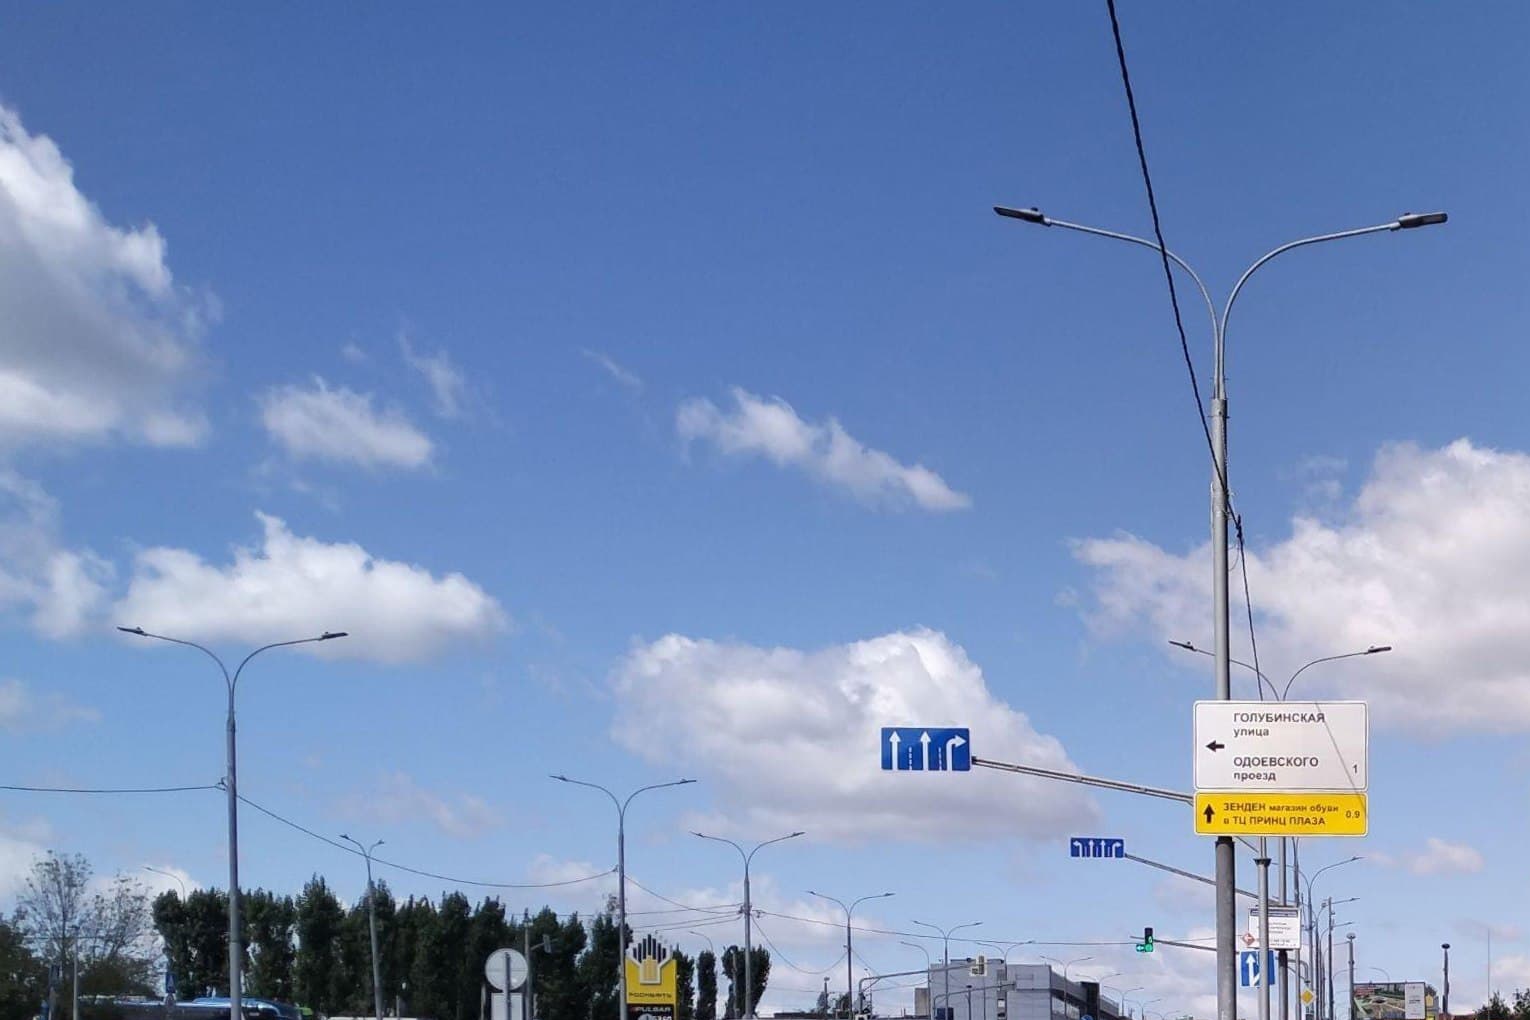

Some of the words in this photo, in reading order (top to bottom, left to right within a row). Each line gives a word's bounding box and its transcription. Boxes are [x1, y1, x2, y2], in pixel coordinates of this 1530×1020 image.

[1233, 712, 1326, 723] ГОЛУБИНСКАЯ
[1233, 727, 1270, 738] улица
[1233, 756, 1319, 769] ОДОЕВСКОГО
[1352, 764, 1359, 775] 1
[1233, 772, 1276, 782] проезд
[1223, 802, 1266, 812] ЗЕНДЕН
[1269, 804, 1307, 812] магазин
[1309, 803, 1339, 814] обуви
[1345, 810, 1361, 819] 0.9
[1233, 816, 1247, 826] ТЦ
[1250, 816, 1287, 827] ПРИНЦ
[1290, 816, 1326, 826] ПЛАЗА
